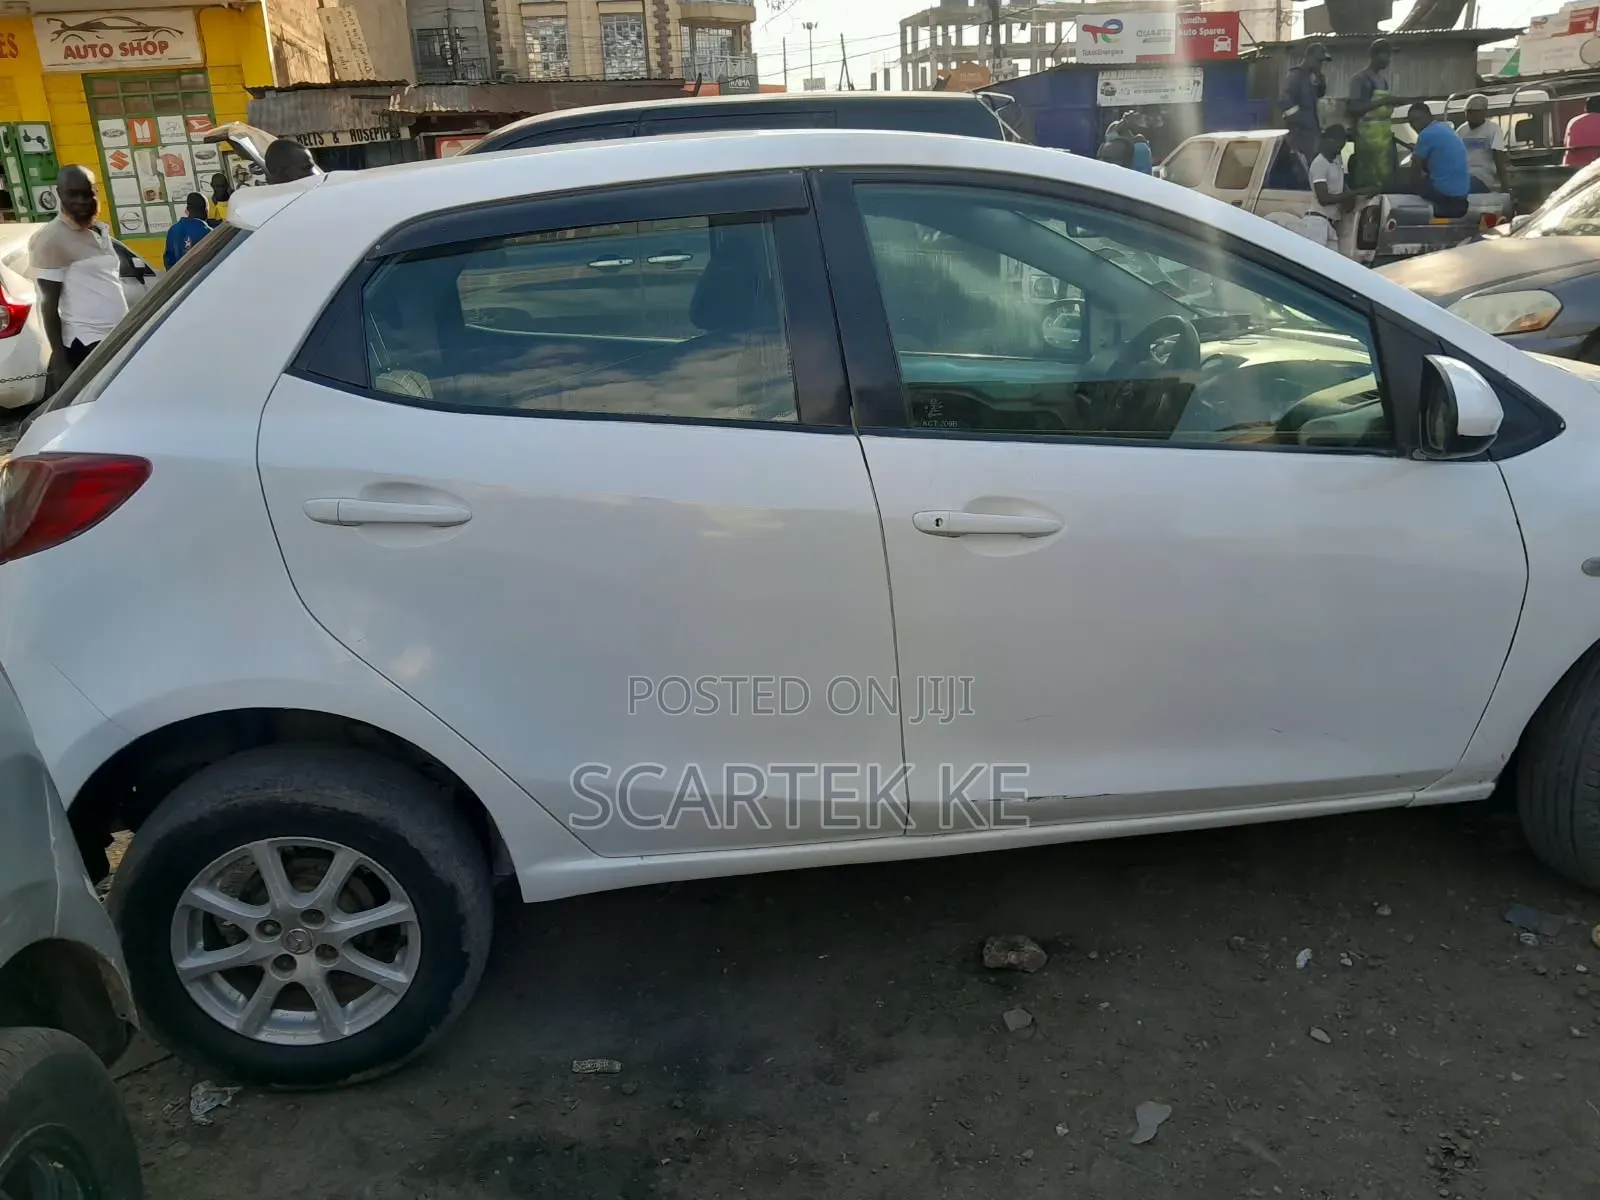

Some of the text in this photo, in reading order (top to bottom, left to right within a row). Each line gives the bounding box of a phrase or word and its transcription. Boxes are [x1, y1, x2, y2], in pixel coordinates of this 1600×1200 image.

[1199, 27, 1226, 37] Spares
[63, 40, 169, 60] AUTO SHOP
